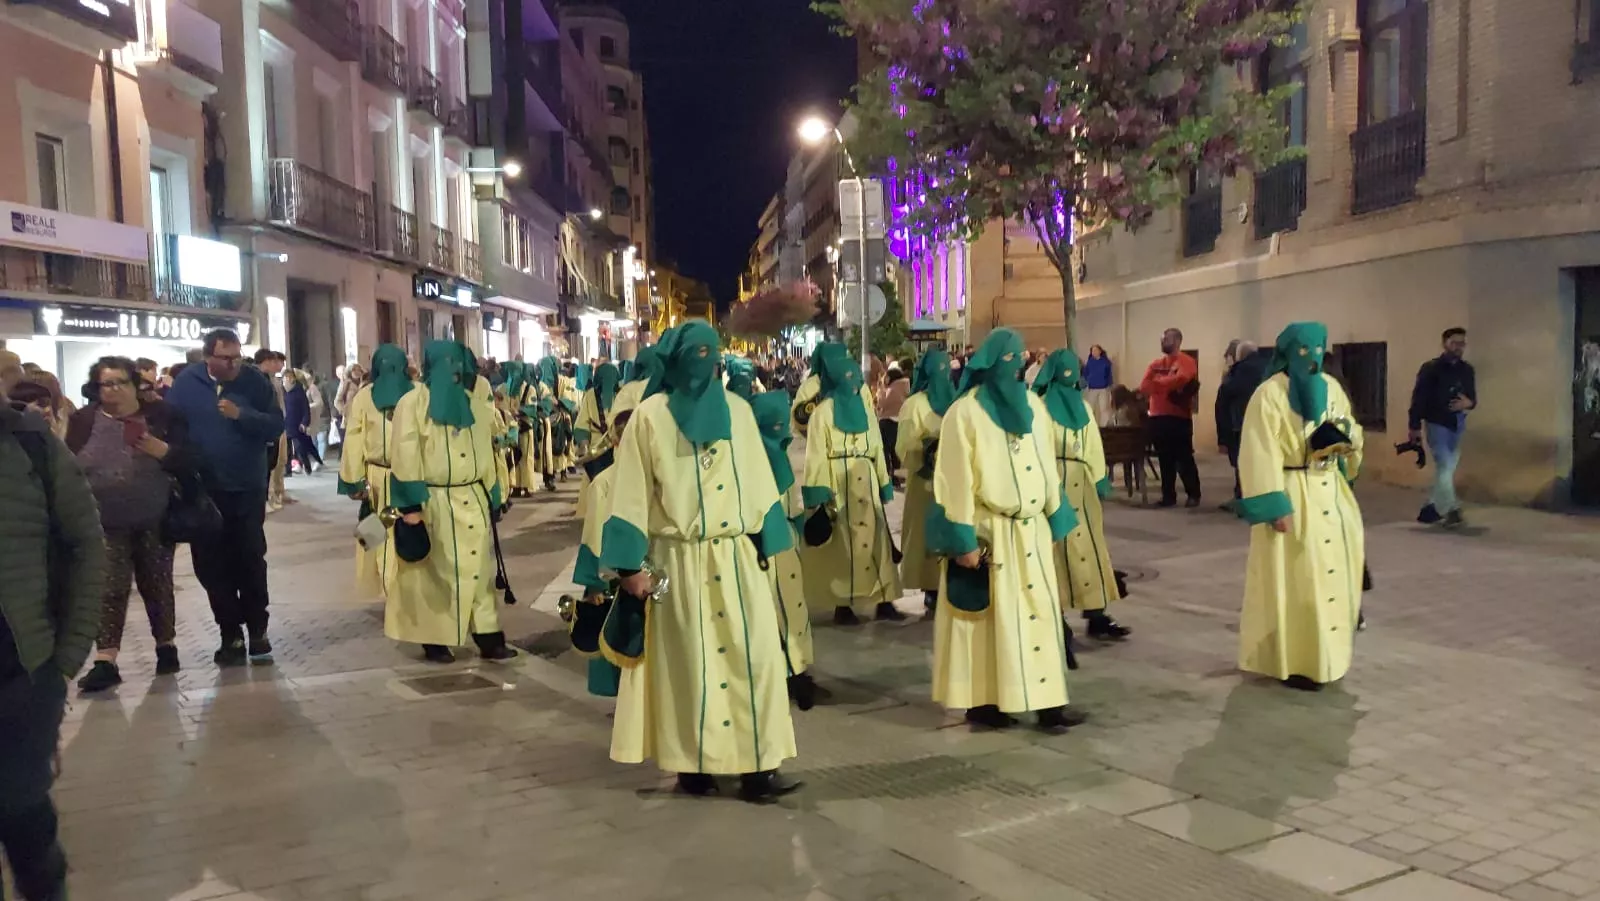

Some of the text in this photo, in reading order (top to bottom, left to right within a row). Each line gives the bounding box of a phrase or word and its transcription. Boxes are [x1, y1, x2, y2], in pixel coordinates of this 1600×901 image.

[25, 214, 56, 230] REALE
[425, 282, 439, 296] IN
[119, 313, 140, 336] EL
